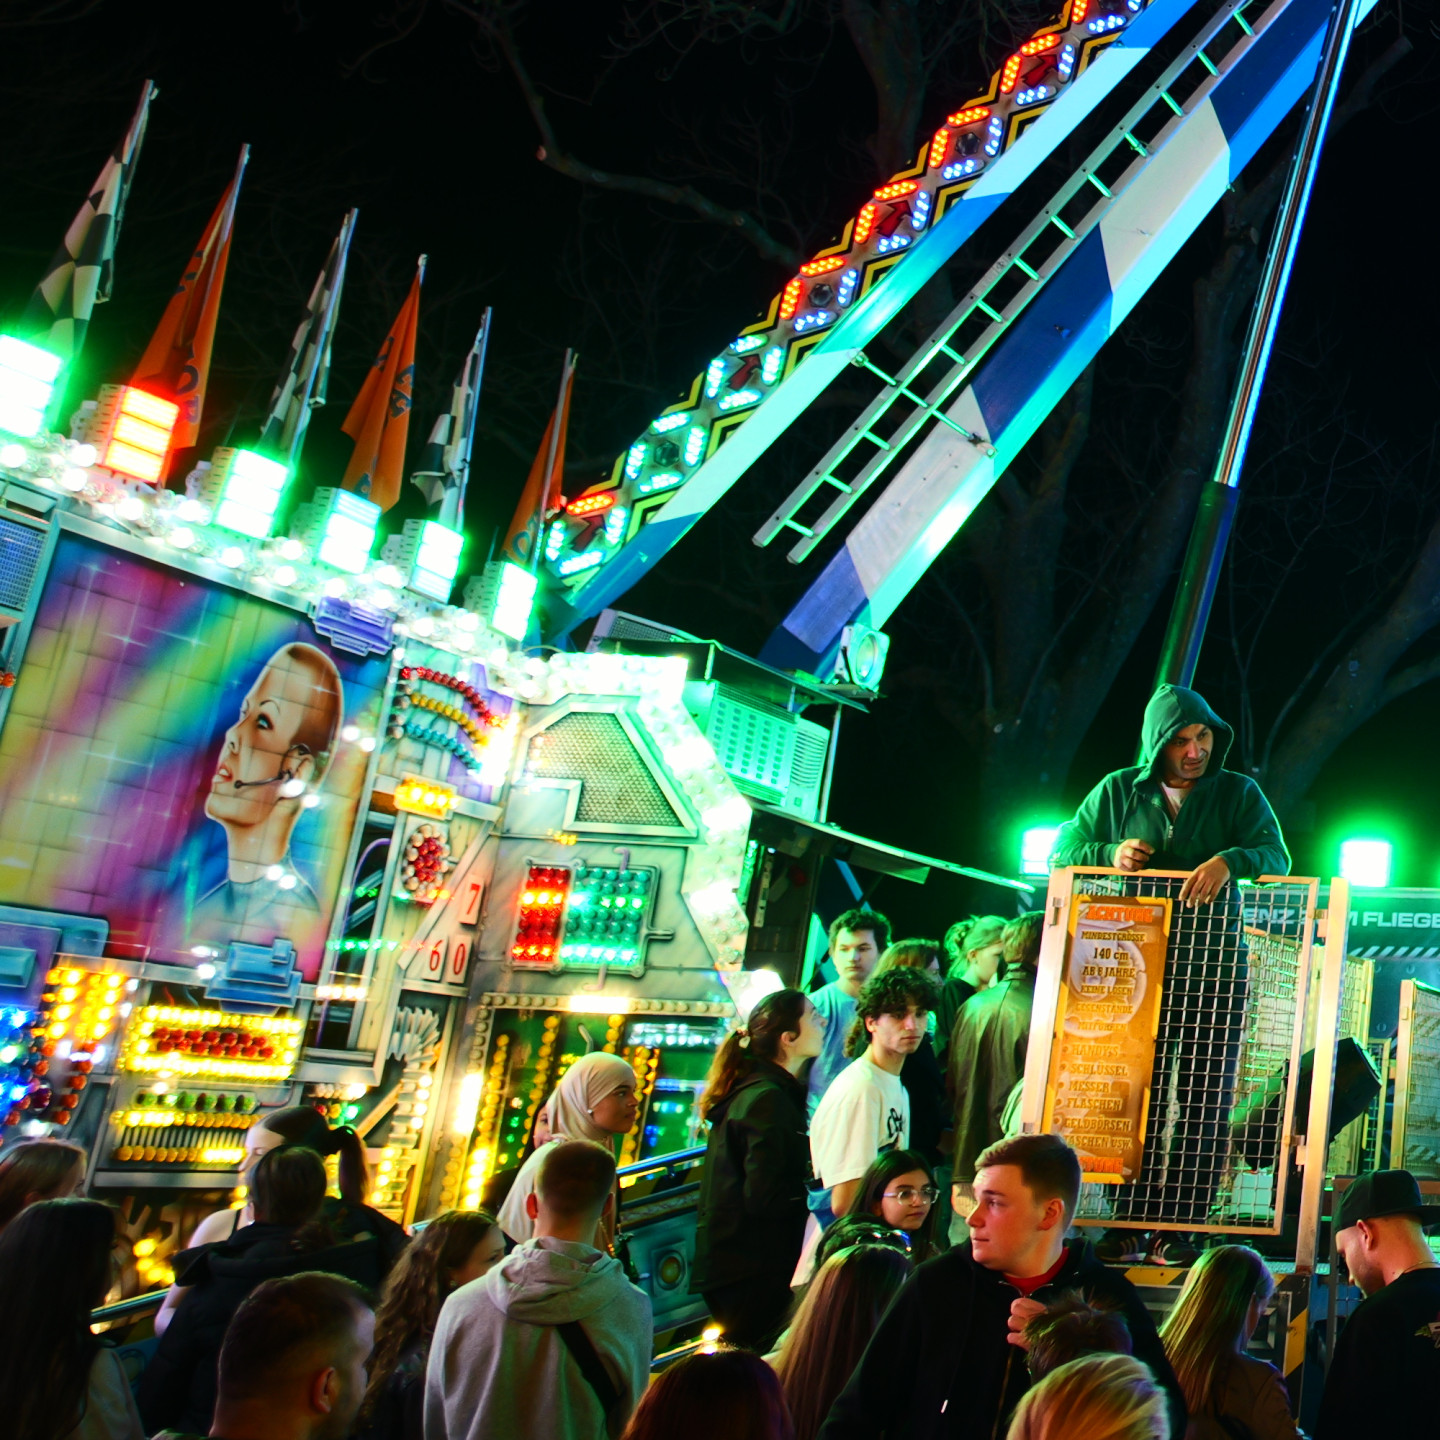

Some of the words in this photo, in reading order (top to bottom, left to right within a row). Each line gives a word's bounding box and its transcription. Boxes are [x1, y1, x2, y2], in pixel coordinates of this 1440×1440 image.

[1094, 947, 1112, 959] 140
[1114, 951, 1128, 960] cm
[1082, 965, 1096, 976] AB
[1104, 966, 1136, 978] JAHRE
[1069, 1061, 1128, 1076] SCHLÜSSEL
[1068, 1081, 1110, 1093] MESSER
[1066, 1097, 1122, 1110] FLASCHEN
